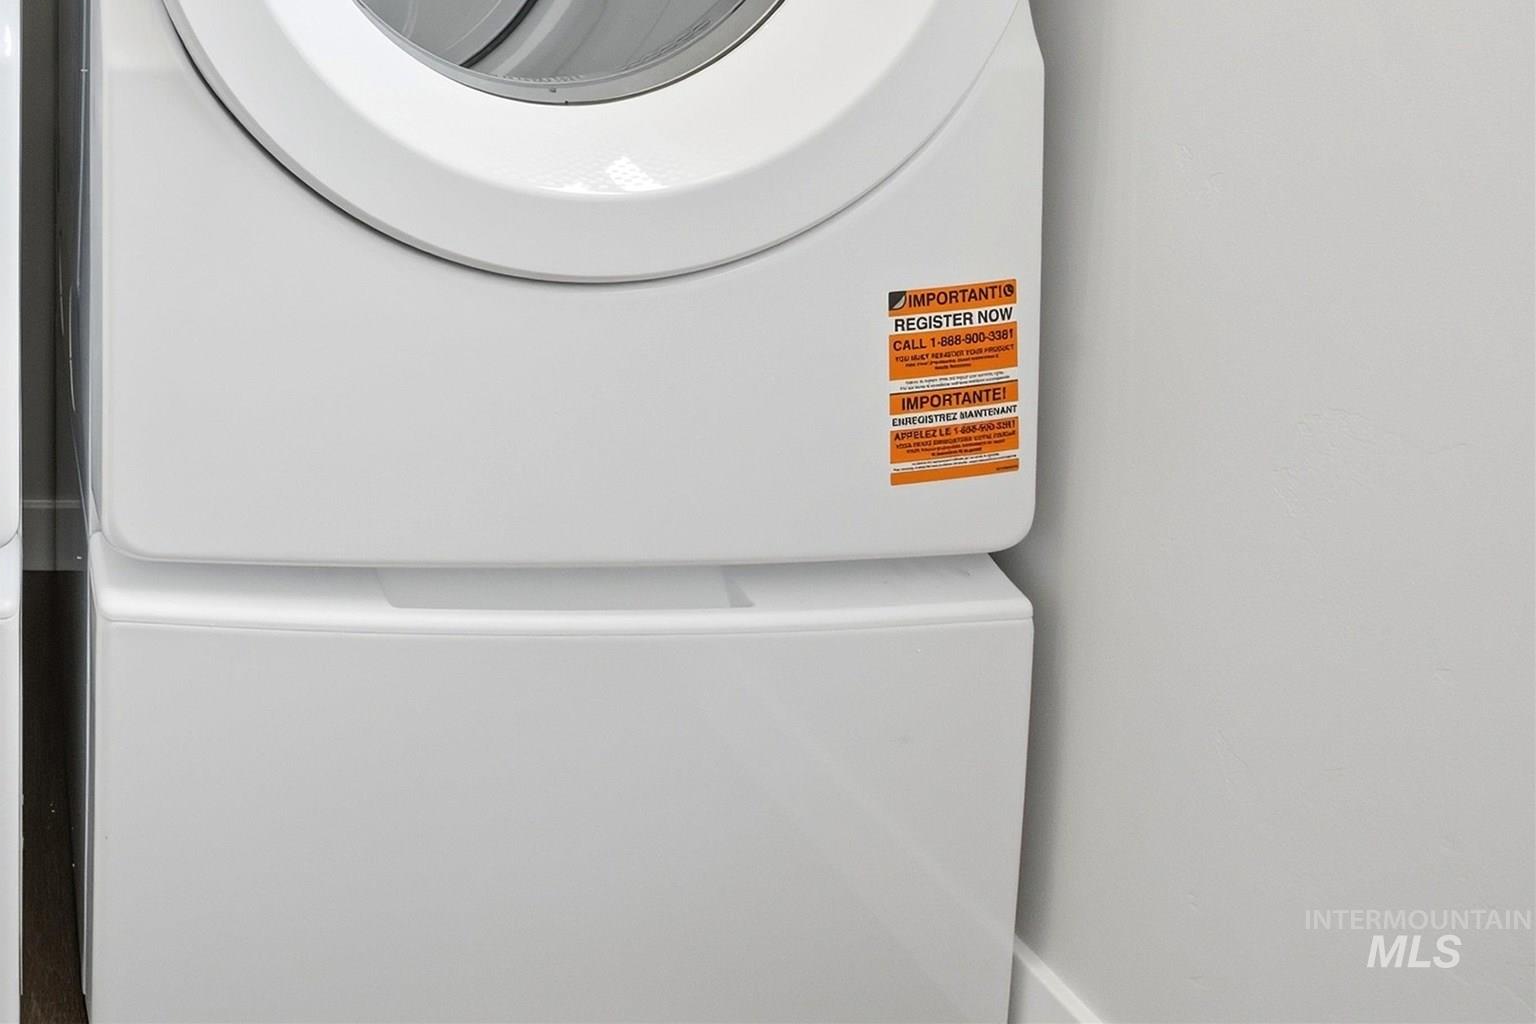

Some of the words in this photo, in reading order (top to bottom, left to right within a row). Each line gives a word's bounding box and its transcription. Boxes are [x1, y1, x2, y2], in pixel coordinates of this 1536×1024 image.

[908, 285, 1002, 308] IMPORTANT!
[894, 312, 973, 332] REGISTER
[978, 307, 1013, 324] NOW
[893, 338, 926, 351] CALL
[901, 387, 1006, 411] IMPORTANTE!
[892, 412, 957, 427] ENREGISTREZ
[960, 405, 1017, 419] MAINTENANT
[894, 430, 937, 441] APPELEZ
[939, 427, 951, 435] LE
